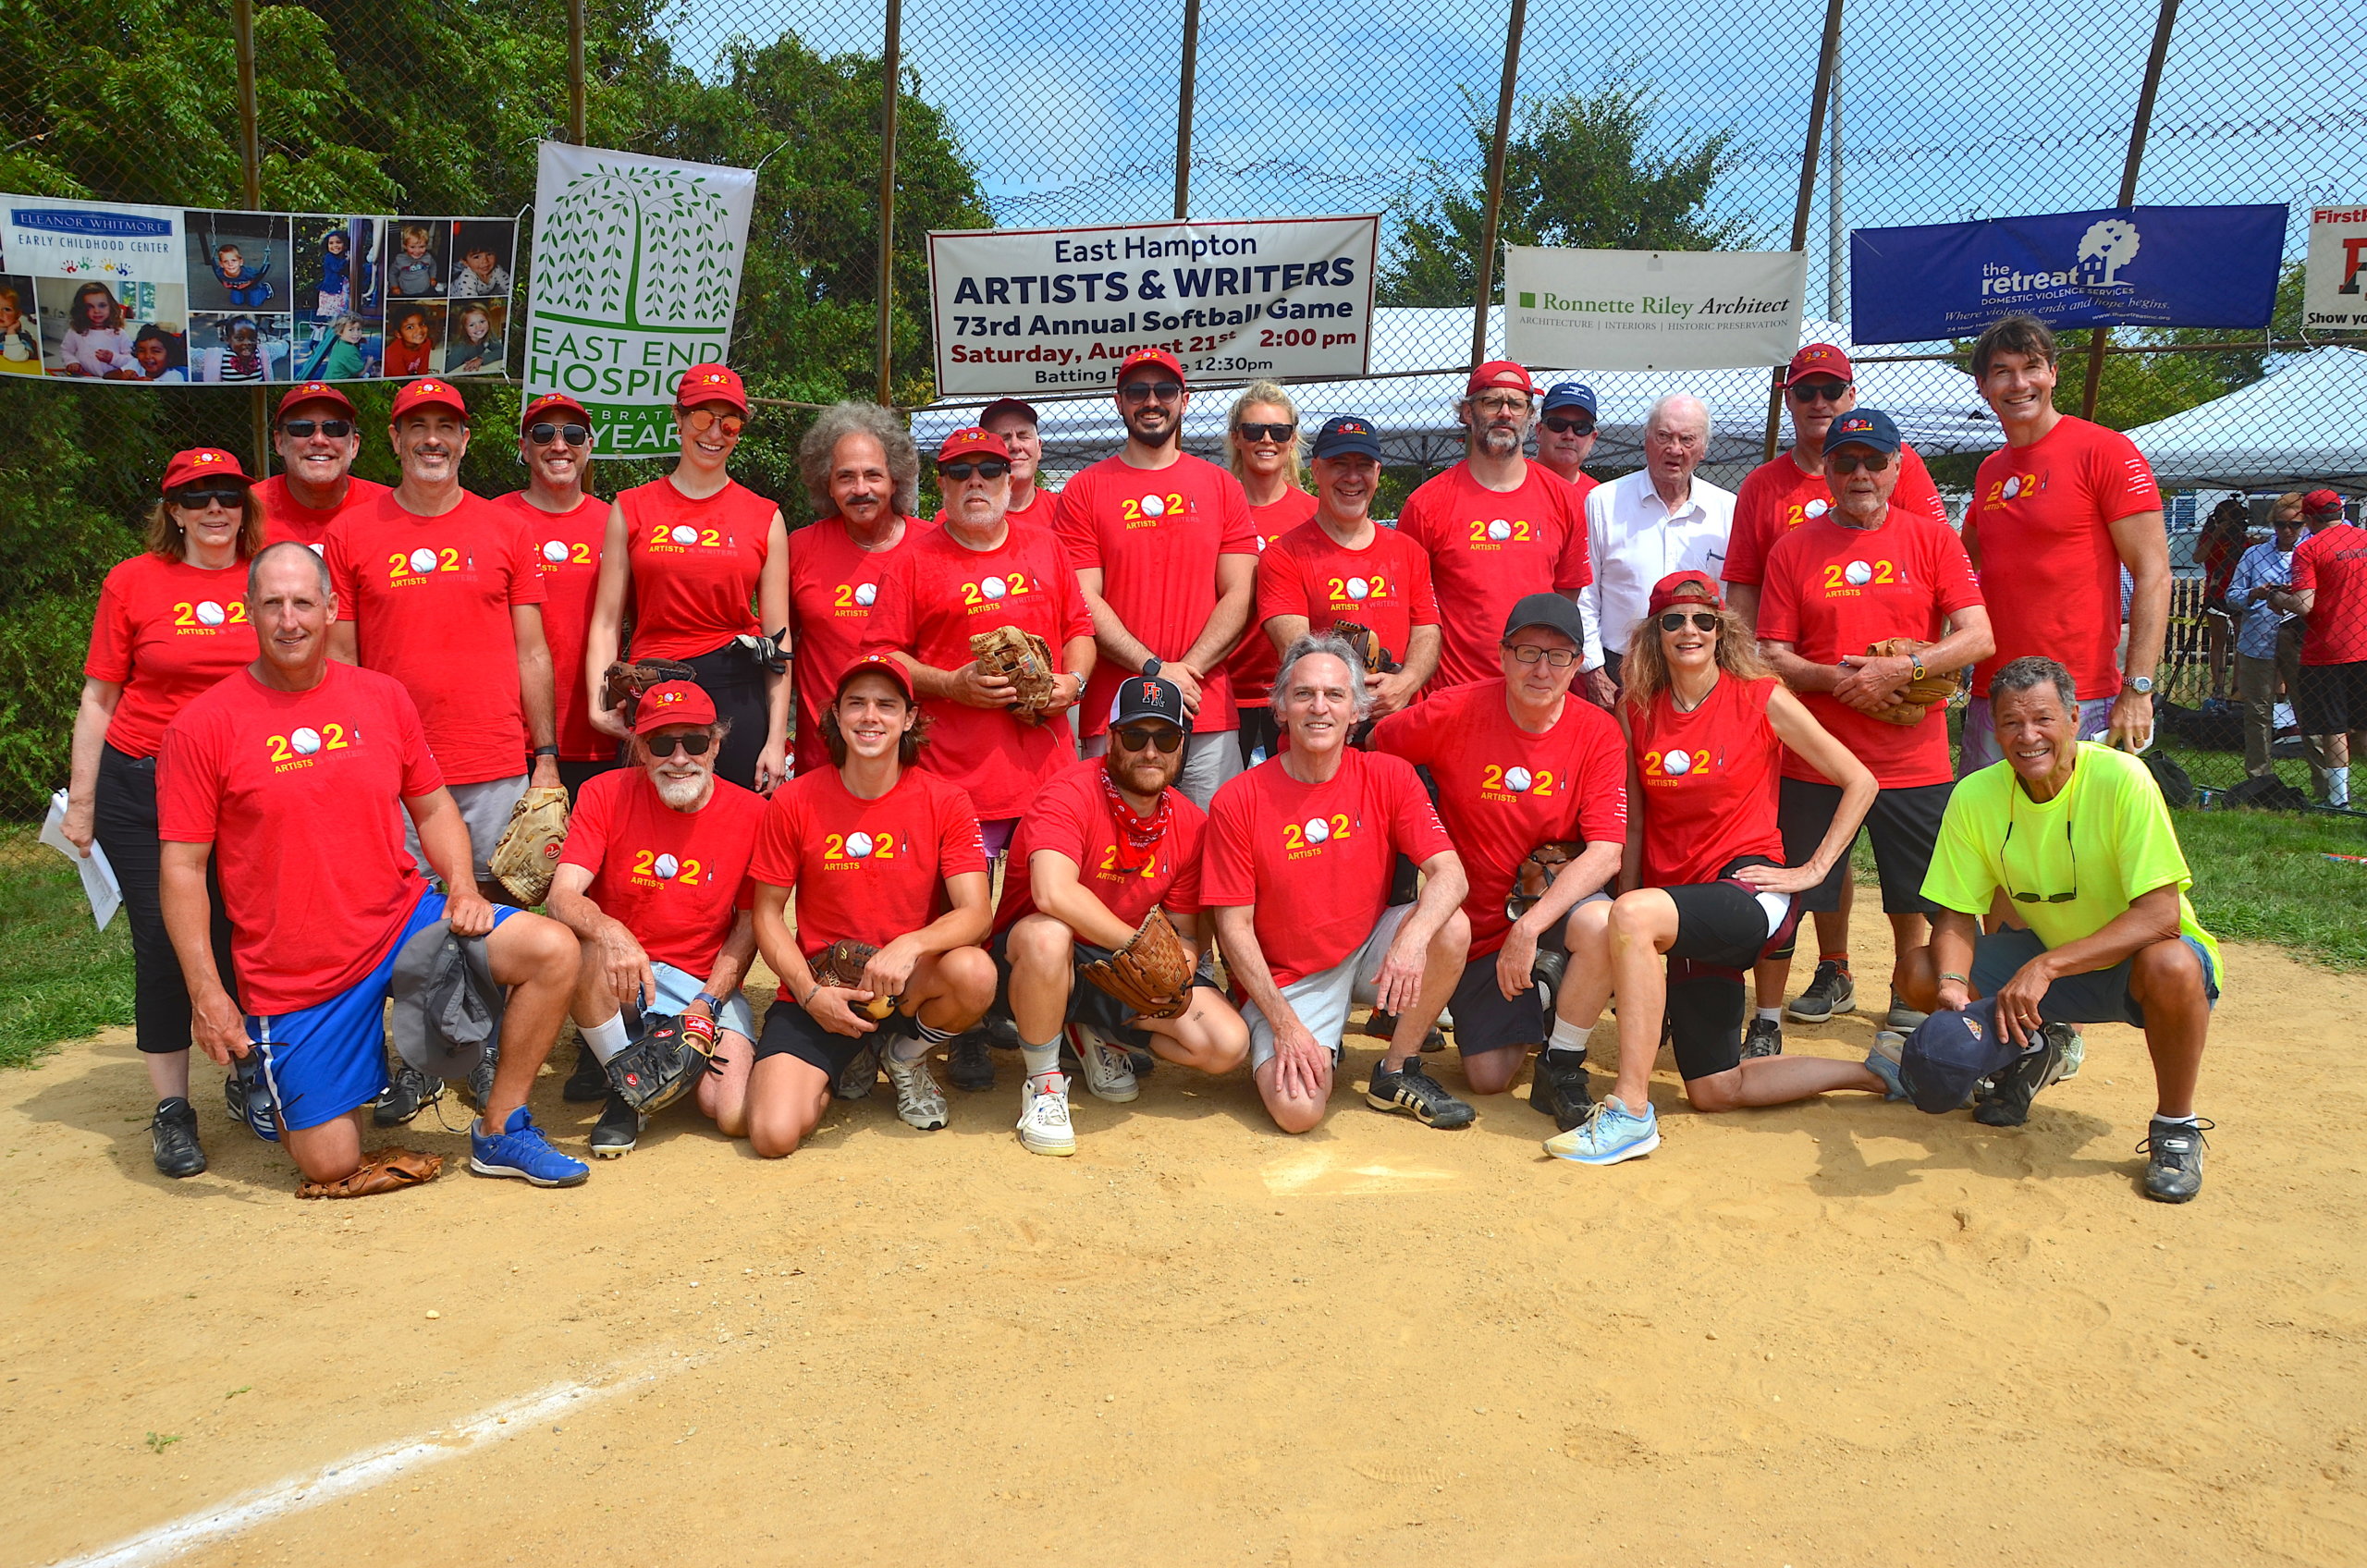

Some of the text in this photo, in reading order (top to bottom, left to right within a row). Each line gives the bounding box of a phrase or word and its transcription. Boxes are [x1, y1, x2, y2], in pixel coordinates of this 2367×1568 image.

[20, 214, 165, 232] ELEANOR WHITMORE
[2313, 209, 2367, 224] First
[18, 234, 169, 253] EARLY CHILDHOOD CENTER
[1055, 234, 1257, 263] East Hampton
[1982, 263, 2010, 277] the
[953, 257, 1355, 304] ARTISTS & WRITERS
[1981, 264, 2079, 295] retreat
[1981, 287, 2135, 306] DOMESTIC VIOLENCE SERVICES
[1542, 292, 1790, 319] Ronnette Riley Architect
[1944, 311, 1982, 322] Where
[1986, 307, 2035, 316] violence
[2038, 301, 2066, 313] ends
[2069, 297, 2092, 311] and
[2094, 297, 2125, 308] hope
[953, 297, 1354, 337] 73rd Annual Softball Game
[1519, 315, 1788, 331] ARCHITECTURE INTERIORS HISTORIC PRESERVATION
[2307, 312, 2348, 325] Show
[532, 326, 723, 366] EAST END
[950, 343, 1082, 366] Saturday,
[1189, 330, 1237, 352] 21st
[1259, 328, 1317, 348] 2:00
[1322, 331, 1356, 349] pm
[1195, 357, 1272, 373] 12:30pm
[529, 356, 688, 396] HOSPIC
[1035, 368, 1107, 384] Batting
[589, 423, 682, 448] YEAR
[1125, 520, 1157, 531] ARTISTS
[390, 576, 427, 589] ARTISTS
[1825, 589, 1861, 599] ARTISTS
[967, 602, 1000, 616] ARTISTS
[1331, 603, 1359, 611] ARTISTS
[275, 758, 314, 774] ARTISTS
[1647, 778, 1678, 787] ARTISTS
[1480, 791, 1517, 802] ARTISTS
[1287, 847, 1322, 861] ARTISTS
[824, 862, 860, 871] ARTISTS
[631, 876, 665, 890] ARTISTS
